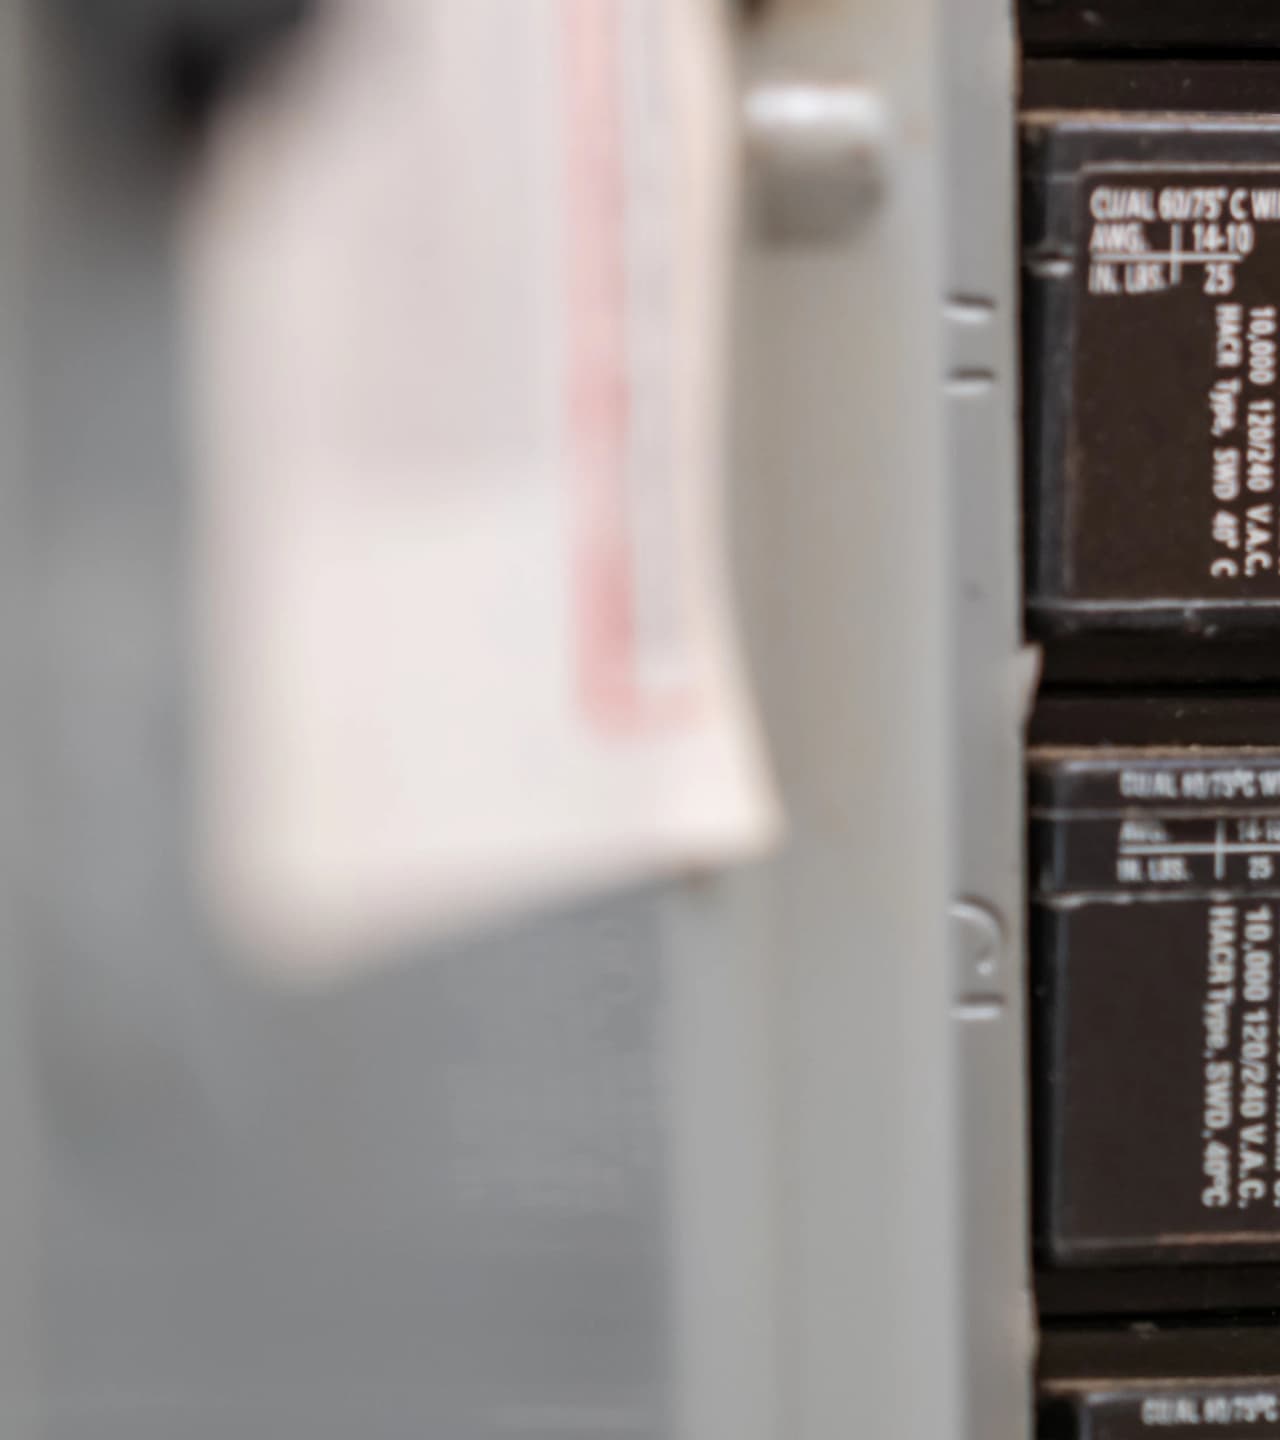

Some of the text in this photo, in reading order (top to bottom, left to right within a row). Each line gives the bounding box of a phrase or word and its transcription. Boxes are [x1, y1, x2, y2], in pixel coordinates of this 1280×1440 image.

[1192, 223, 1253, 256] 14-10
[1204, 265, 1233, 294] 25
[1247, 307, 1276, 384] 10,000
[1213, 448, 1239, 500] SWD
[1247, 400, 1274, 491] 120/240
[1243, 906, 1272, 1001] 10,000
[1240, 1009, 1269, 1118] 120/240
